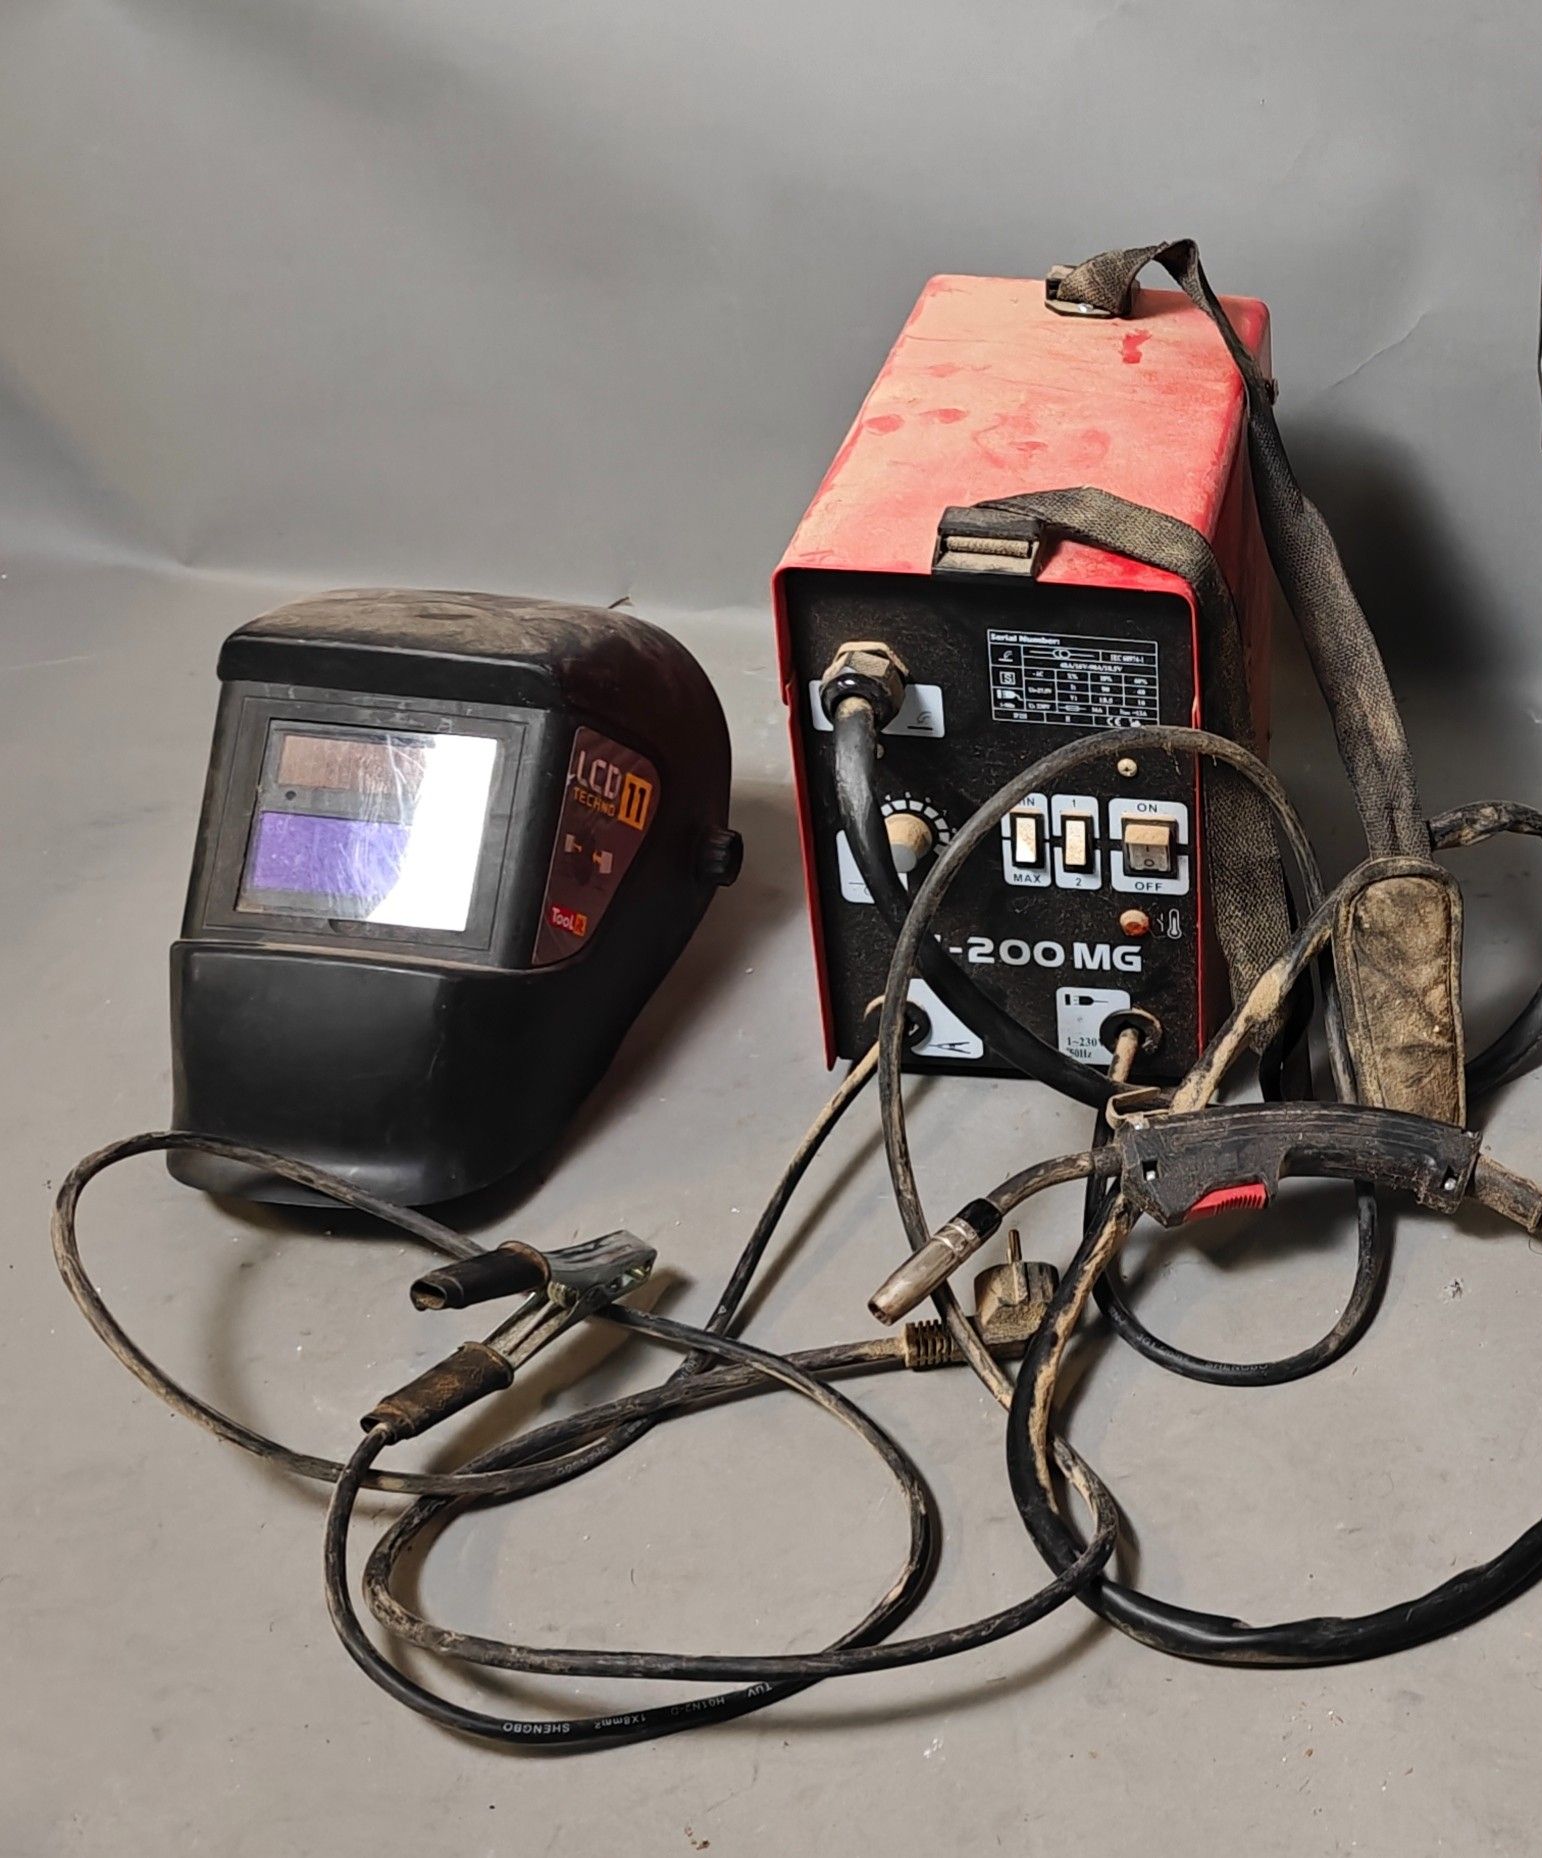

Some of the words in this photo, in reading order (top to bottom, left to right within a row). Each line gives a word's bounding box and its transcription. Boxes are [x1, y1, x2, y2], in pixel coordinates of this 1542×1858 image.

[577, 750, 623, 799] LCD
[573, 786, 616, 817] TECHNO
[1071, 799, 1077, 808] 1
[1136, 803, 1158, 813] ON
[1013, 873, 1041, 884] MAX
[1075, 877, 1082, 887] 2
[1134, 881, 1163, 892] OFF
[1073, 941, 1142, 972] MG
[746, 1681, 773, 1698] TUV
[502, 1722, 571, 1734] SHENGBO
